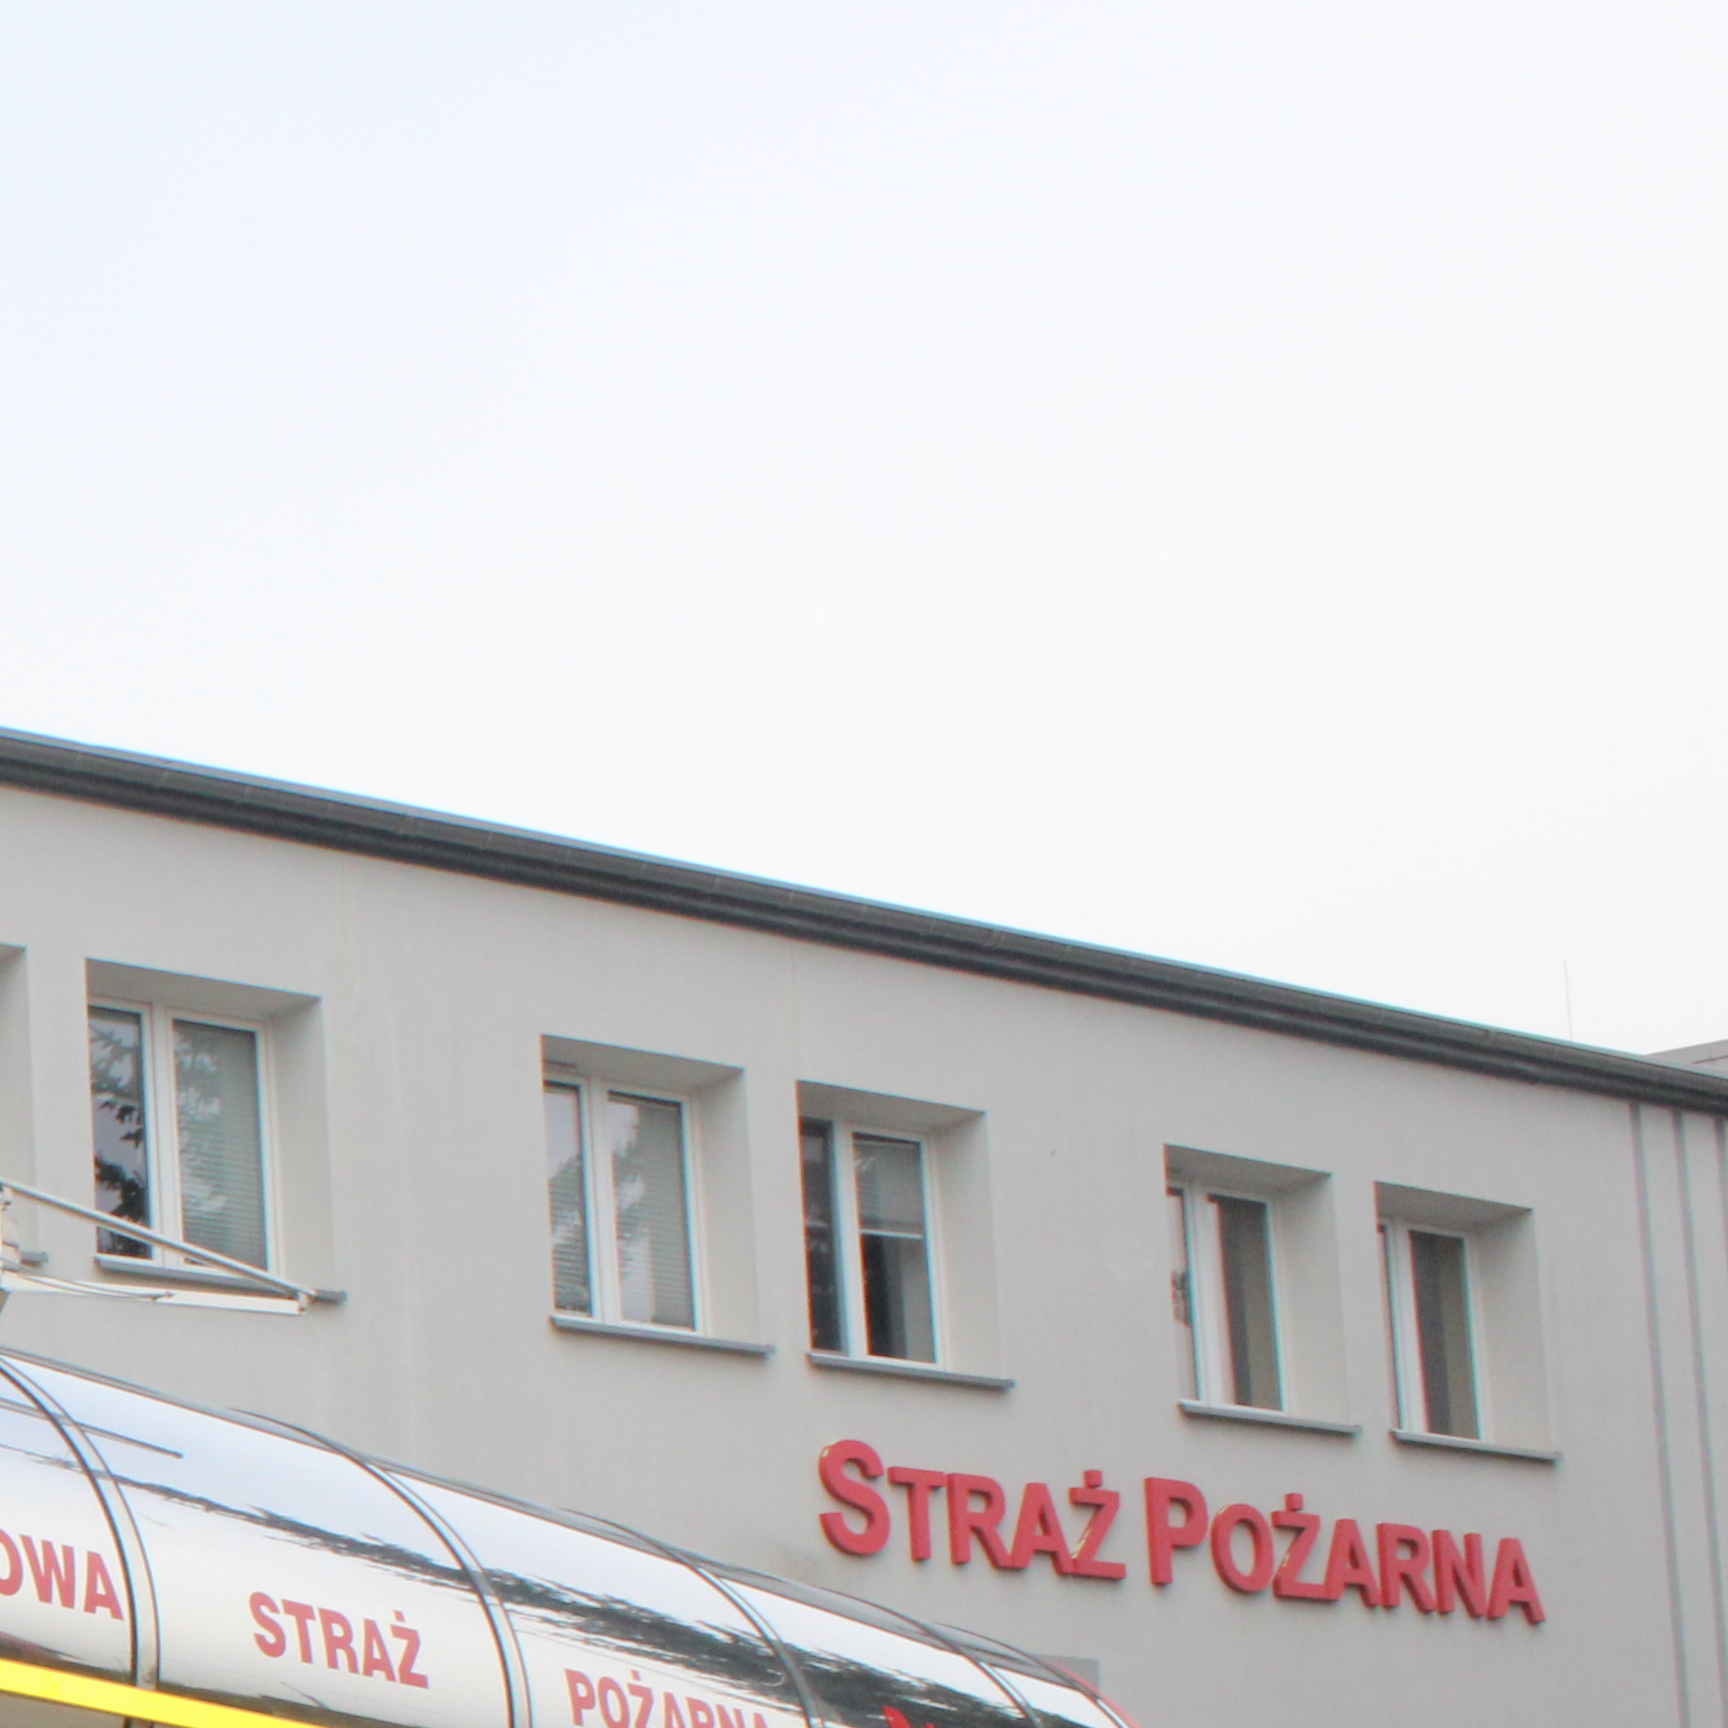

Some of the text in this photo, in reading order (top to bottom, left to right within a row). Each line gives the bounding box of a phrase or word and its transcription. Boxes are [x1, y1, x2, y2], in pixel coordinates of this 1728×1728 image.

[818, 1439, 1545, 1624] STRAŻ POŻARNA
[249, 1592, 429, 1689] STRAŻ
